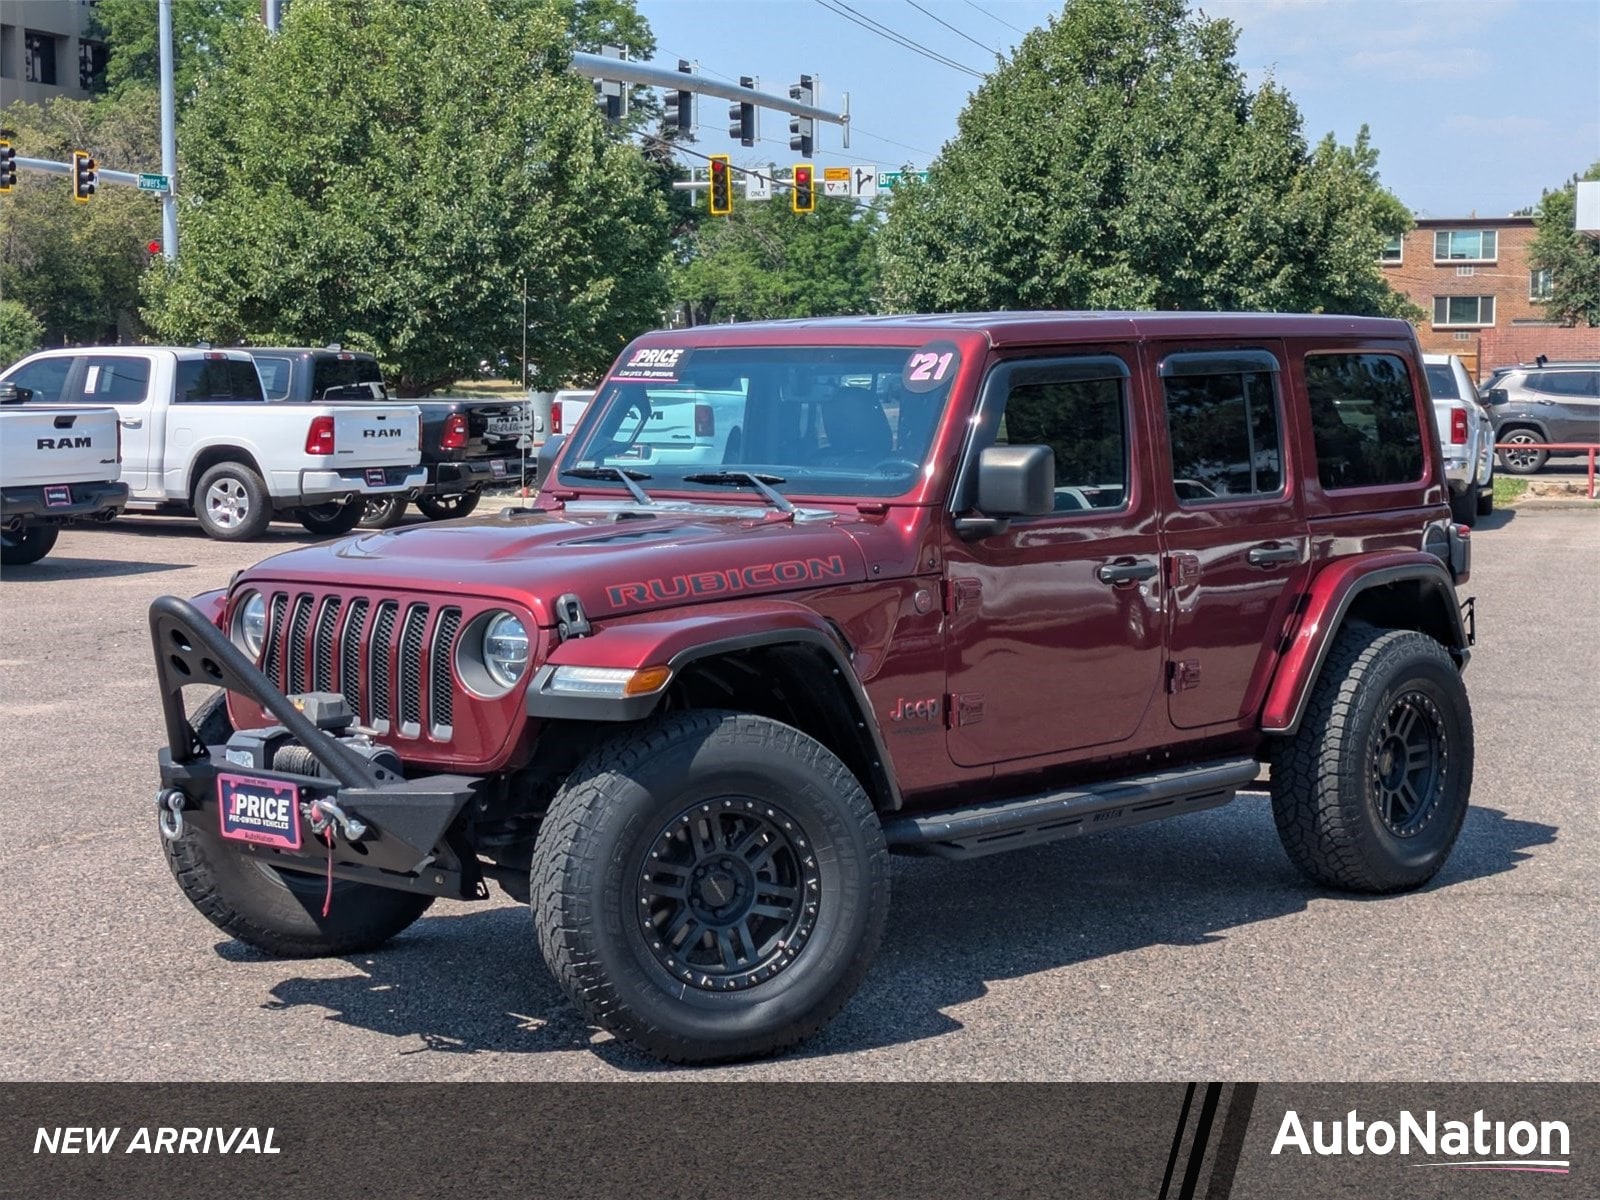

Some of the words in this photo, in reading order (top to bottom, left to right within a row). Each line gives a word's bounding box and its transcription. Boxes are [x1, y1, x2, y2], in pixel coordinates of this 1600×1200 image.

[879, 173, 927, 185] Bray
[750, 190, 766, 198] ONLY
[363, 428, 402, 438] RAM
[37, 437, 91, 450] RAM
[606, 555, 846, 609] RUBICON
[890, 698, 939, 721] Jeep
[229, 814, 262, 826] PRE-OWNED
[262, 819, 289, 830] VEHICLES
